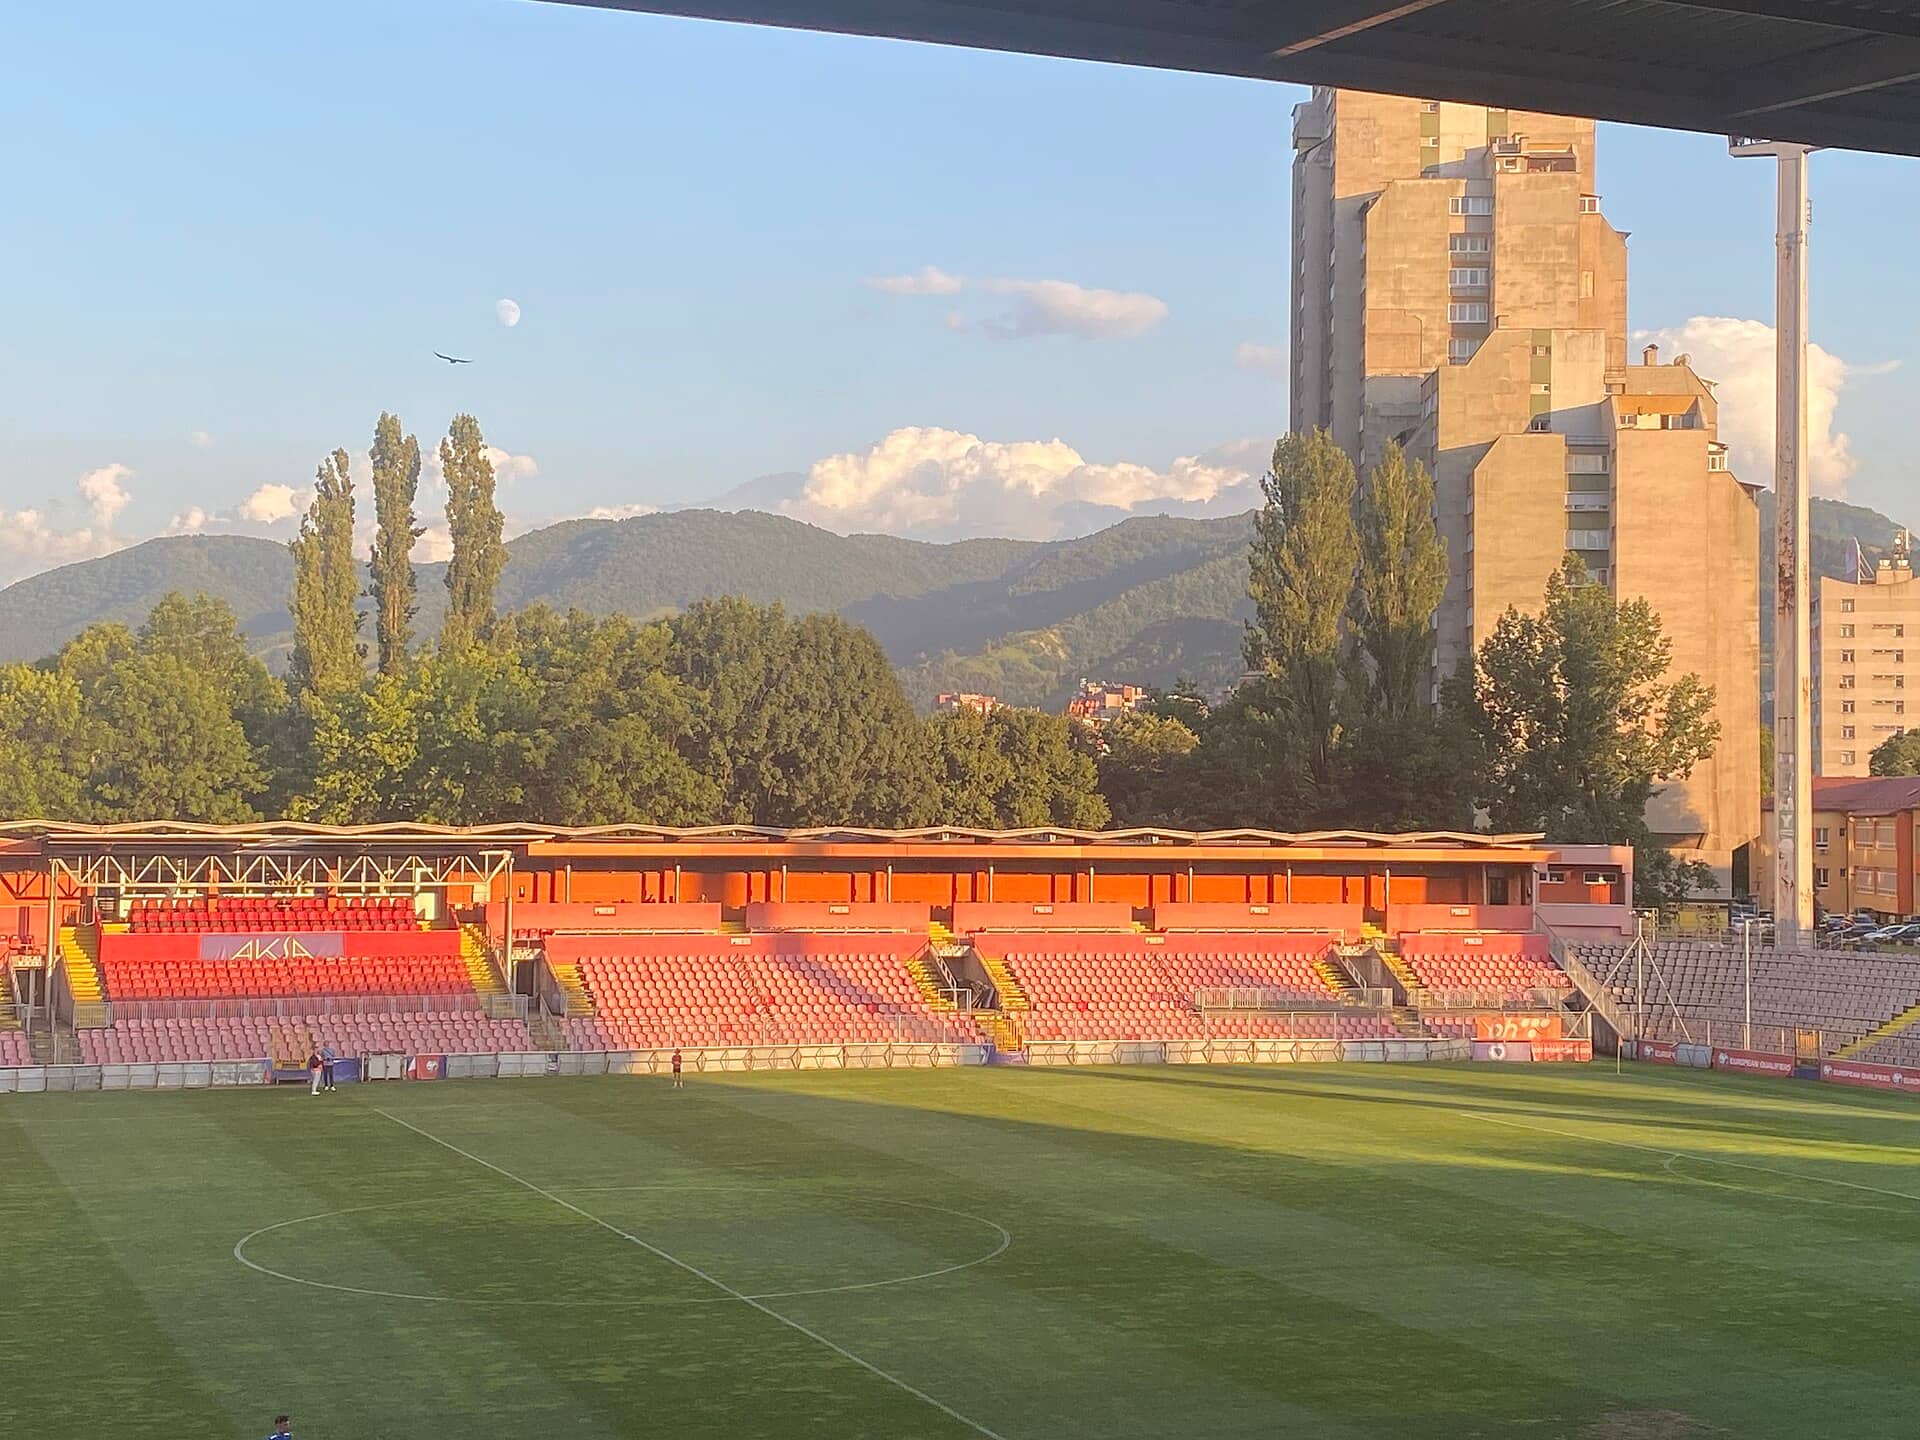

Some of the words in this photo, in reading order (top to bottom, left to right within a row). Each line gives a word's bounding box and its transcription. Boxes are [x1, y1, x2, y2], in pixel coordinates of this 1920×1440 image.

[594, 906, 615, 914] PRESS
[829, 906, 850, 914] PRESS
[1034, 906, 1053, 914] PRESS
[1250, 906, 1269, 914] PRESS
[1451, 907, 1470, 915] PRESS
[730, 937, 751, 945] PRESS
[1145, 937, 1164, 945] PRESS
[1464, 937, 1483, 945] PRESS
[231, 936, 314, 960] AKSA
[1729, 1057, 1759, 1068] EUROPEAN
[1760, 1060, 1791, 1072] QUALIFIERS
[1833, 1069, 1860, 1078] EUROPEAN
